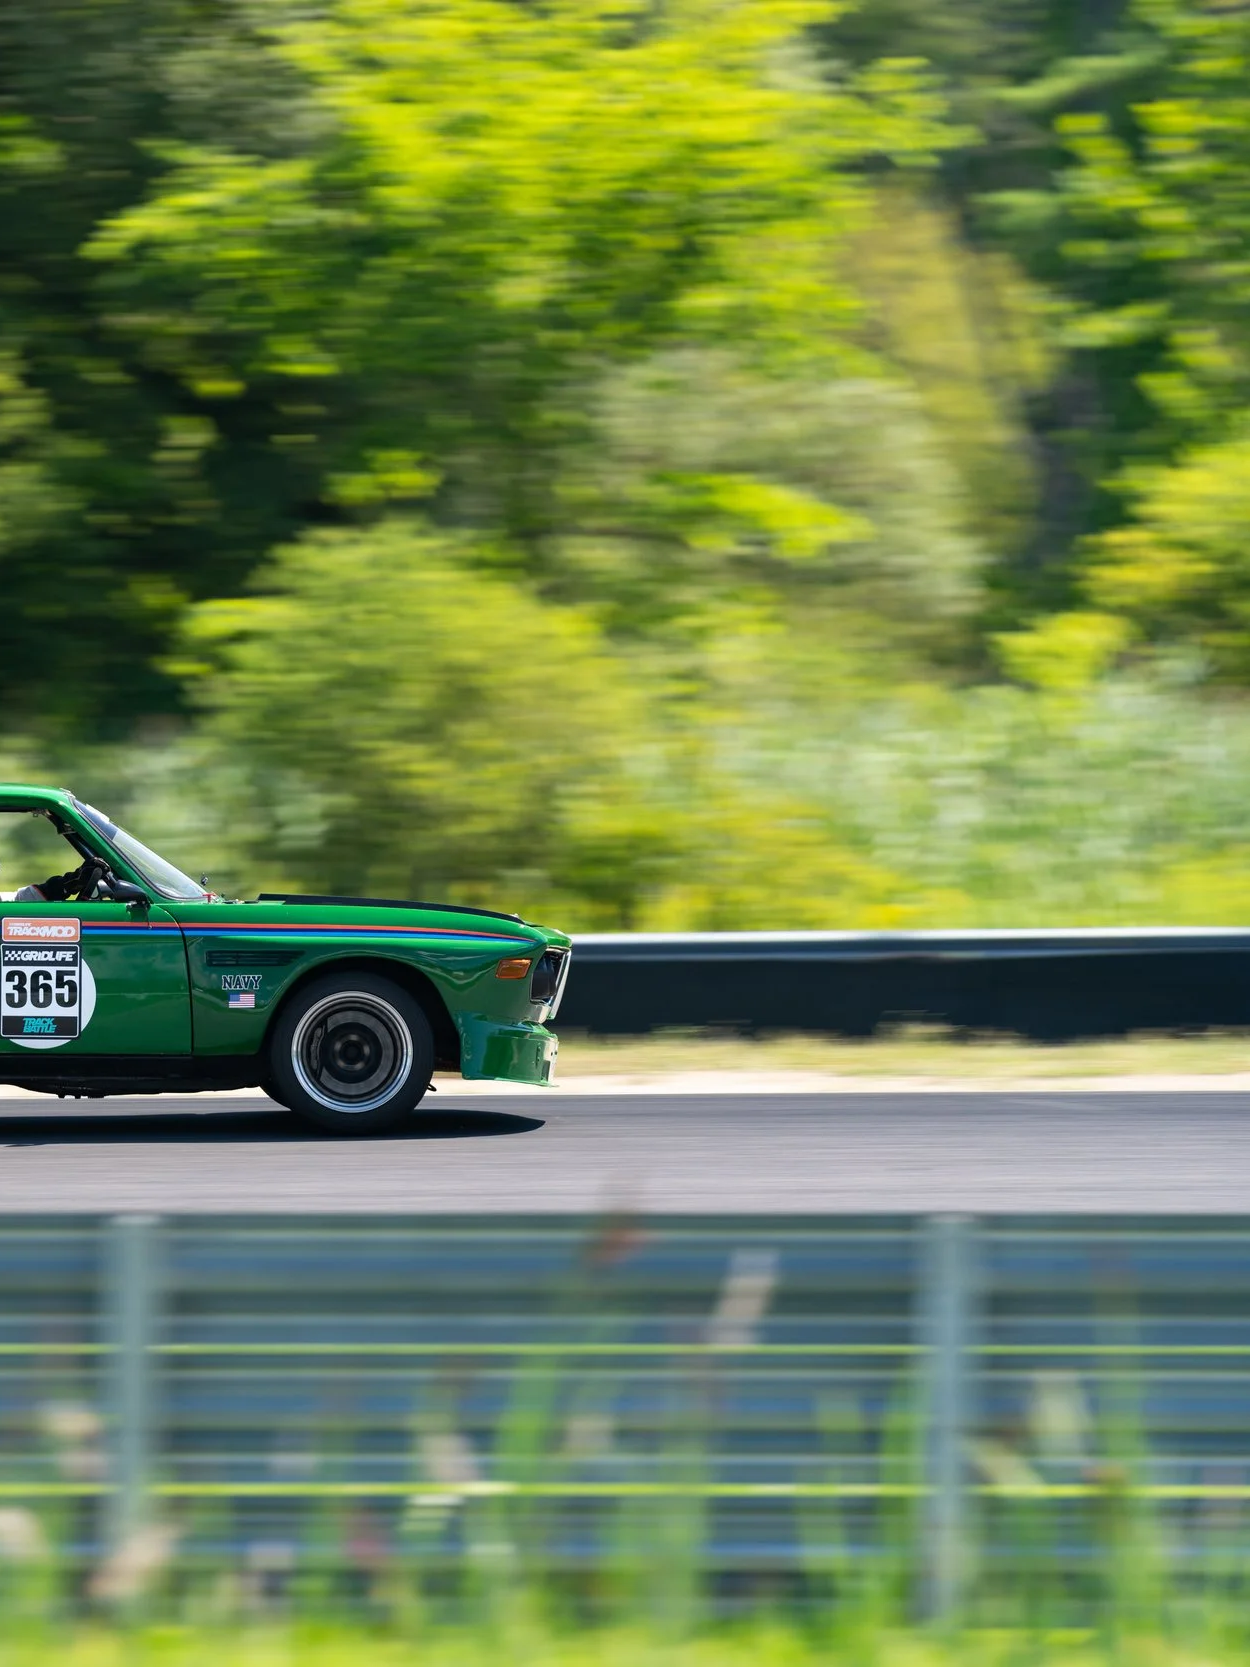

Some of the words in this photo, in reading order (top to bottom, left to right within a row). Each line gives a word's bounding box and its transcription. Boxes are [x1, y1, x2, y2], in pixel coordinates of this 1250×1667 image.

[20, 950, 76, 962] GRIDLIFE
[221, 974, 263, 990] NAVY
[5, 969, 78, 1009] 365
[23, 1017, 55, 1026] TRACK
[23, 1025, 57, 1033] BATTLE
